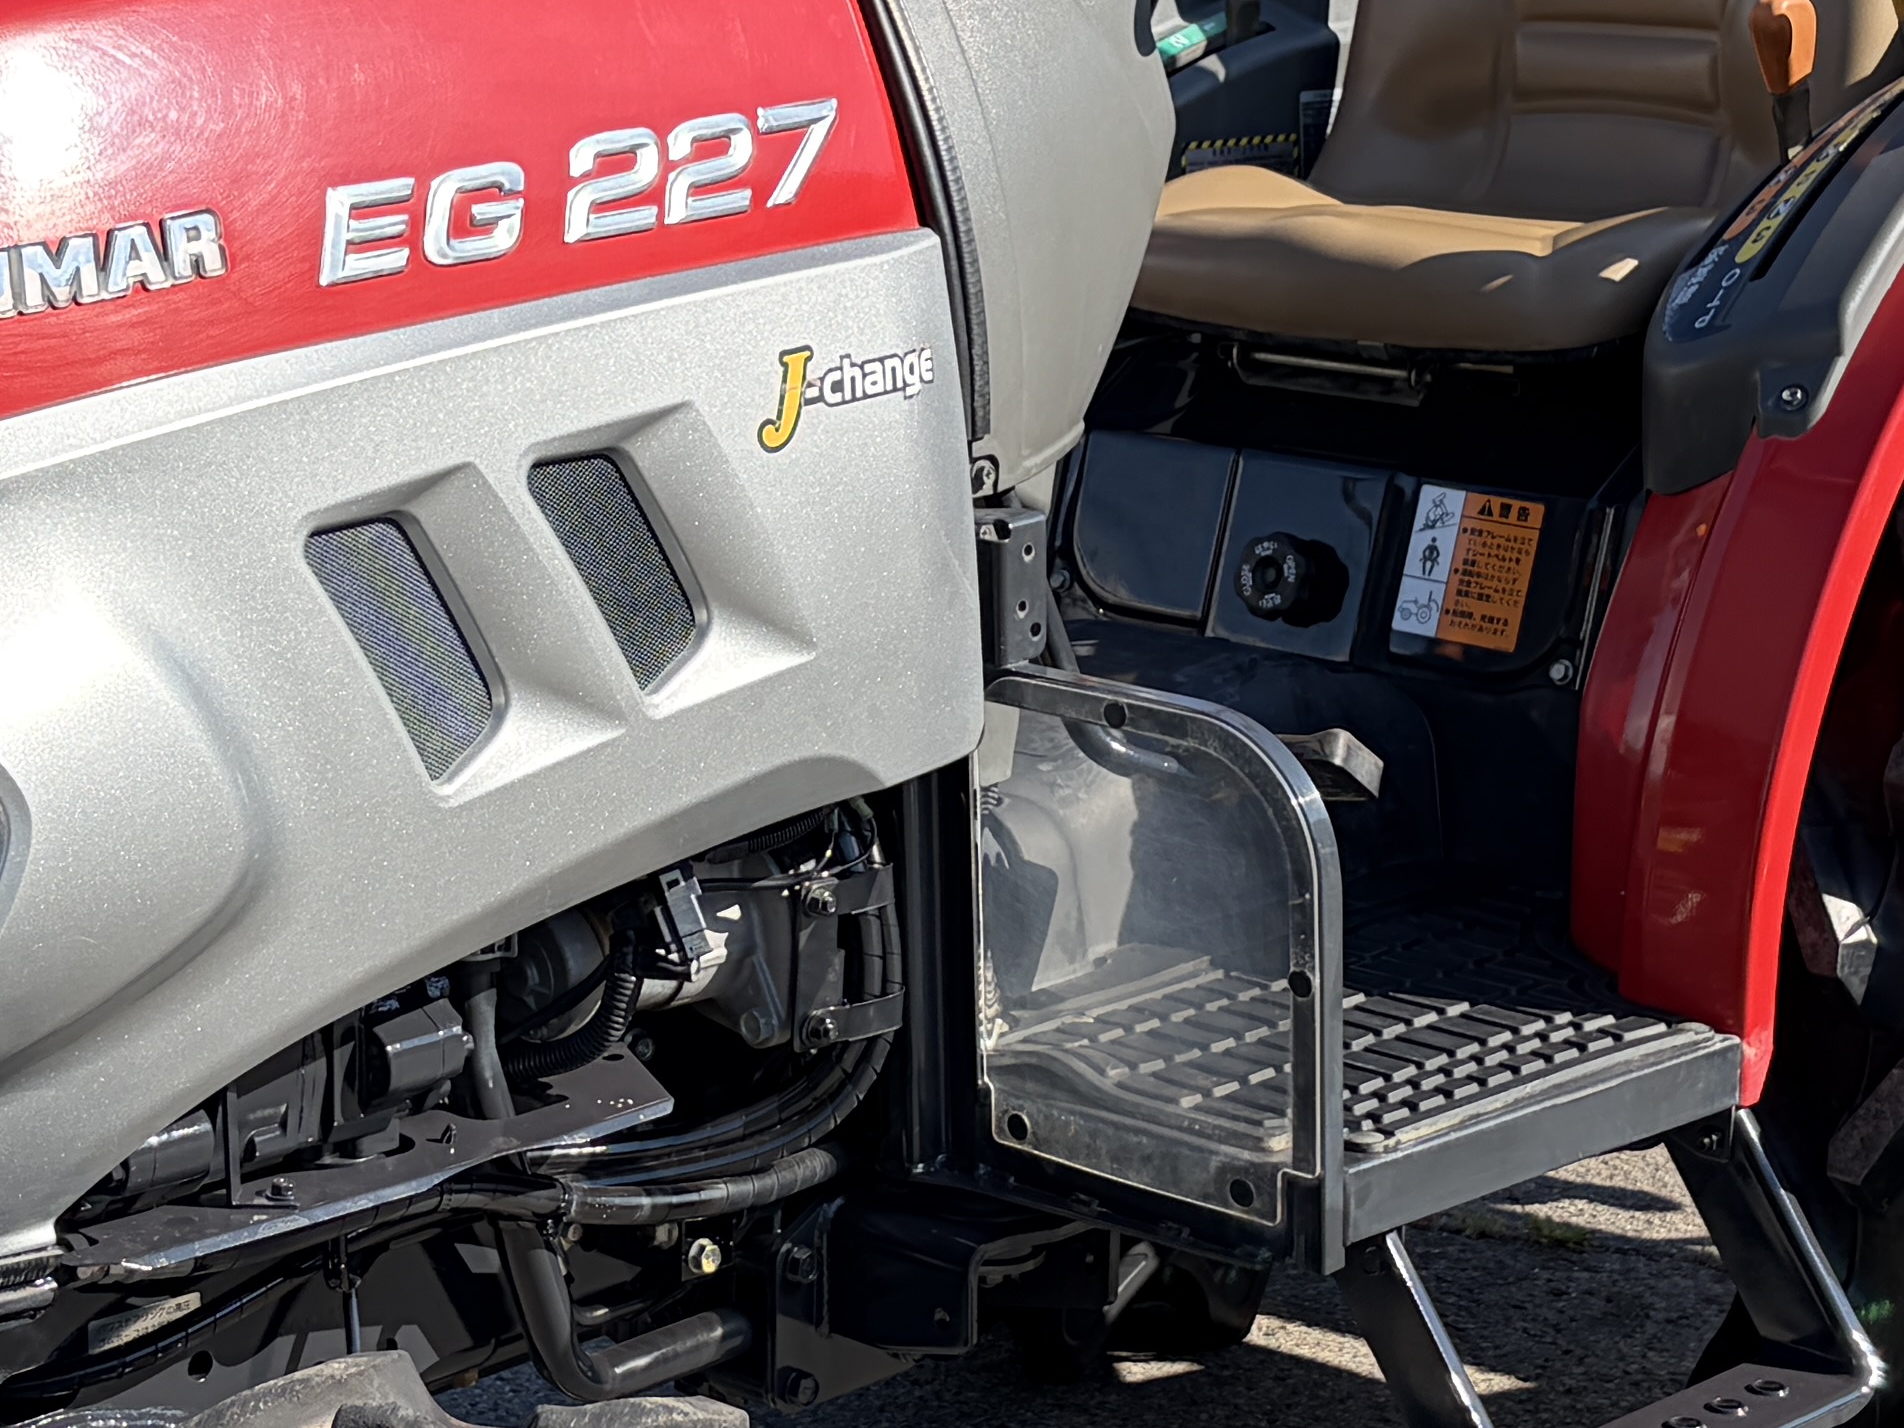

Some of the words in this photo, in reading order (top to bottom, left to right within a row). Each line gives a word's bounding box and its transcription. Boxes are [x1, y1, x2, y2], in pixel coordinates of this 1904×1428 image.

[318, 160, 526, 288] EG
[563, 98, 839, 245] 227
[757, 344, 935, 453] J-change
